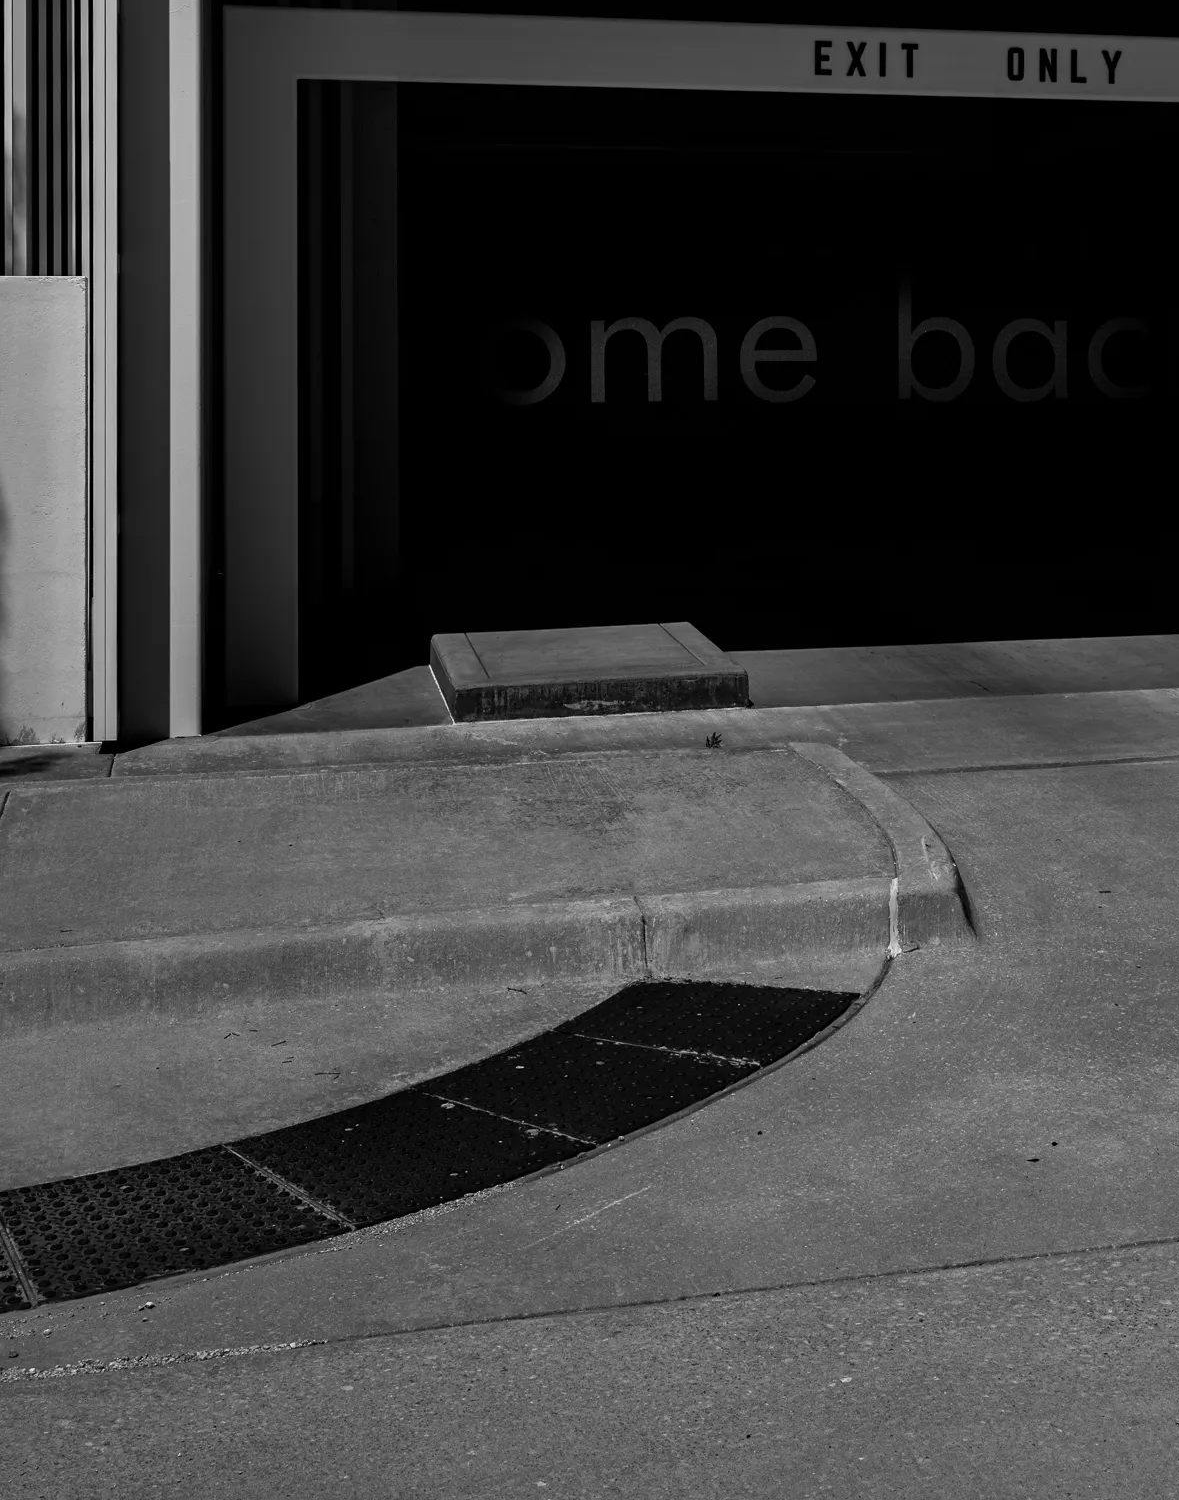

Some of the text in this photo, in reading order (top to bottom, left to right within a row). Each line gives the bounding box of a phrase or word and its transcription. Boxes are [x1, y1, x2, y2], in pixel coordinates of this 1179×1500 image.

[814, 40, 1123, 85] EXIT ONLY
[490, 314, 819, 407] ome
